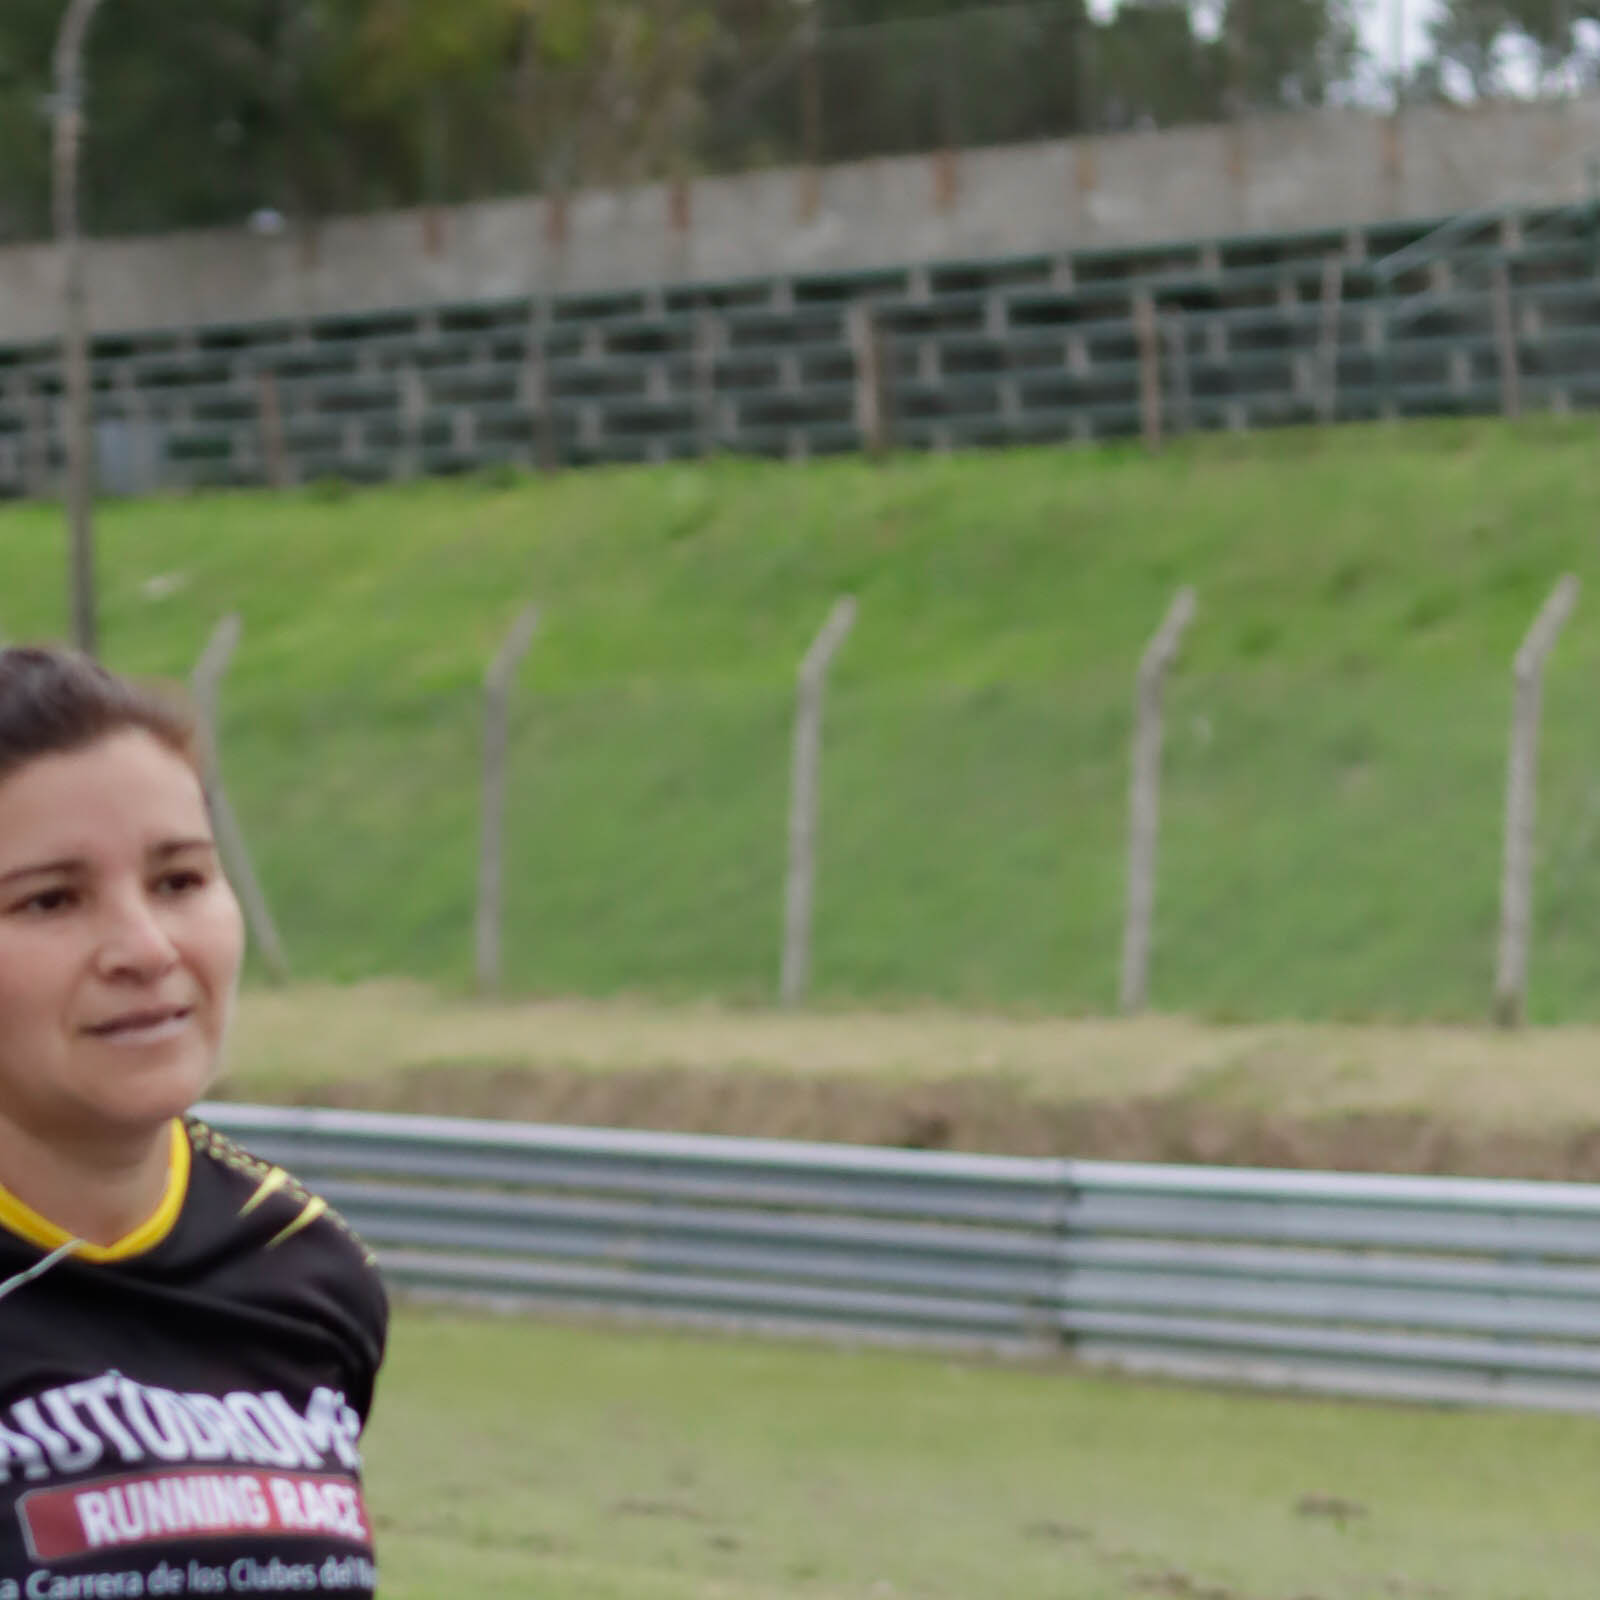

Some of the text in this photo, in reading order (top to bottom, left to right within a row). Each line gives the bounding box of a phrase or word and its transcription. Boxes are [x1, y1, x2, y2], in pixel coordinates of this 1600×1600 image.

[76, 1476, 269, 1547] RUNNING
[148, 1560, 185, 1595] de
[188, 1558, 227, 1592] los
[229, 1556, 317, 1592] Clubes
